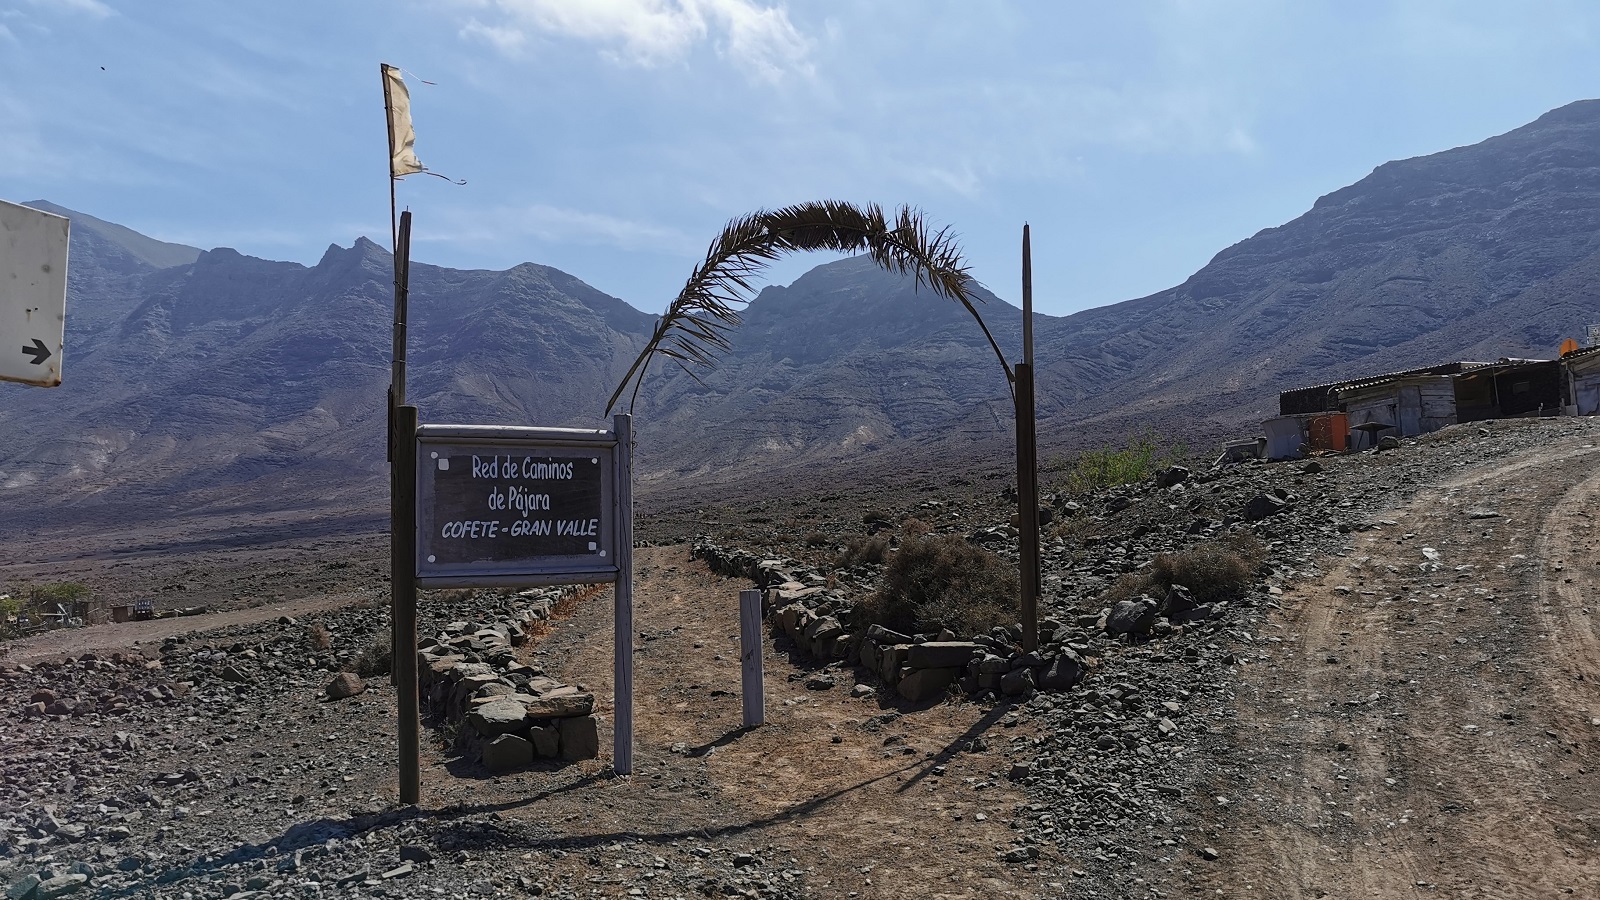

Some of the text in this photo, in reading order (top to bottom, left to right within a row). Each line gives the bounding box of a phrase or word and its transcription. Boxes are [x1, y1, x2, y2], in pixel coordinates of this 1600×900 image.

[472, 454, 574, 480] Red de Caminos
[488, 485, 550, 518] de Pájara
[441, 520, 500, 539] COFETE
[510, 520, 552, 537] GRAN
[556, 518, 599, 537] VALLE
